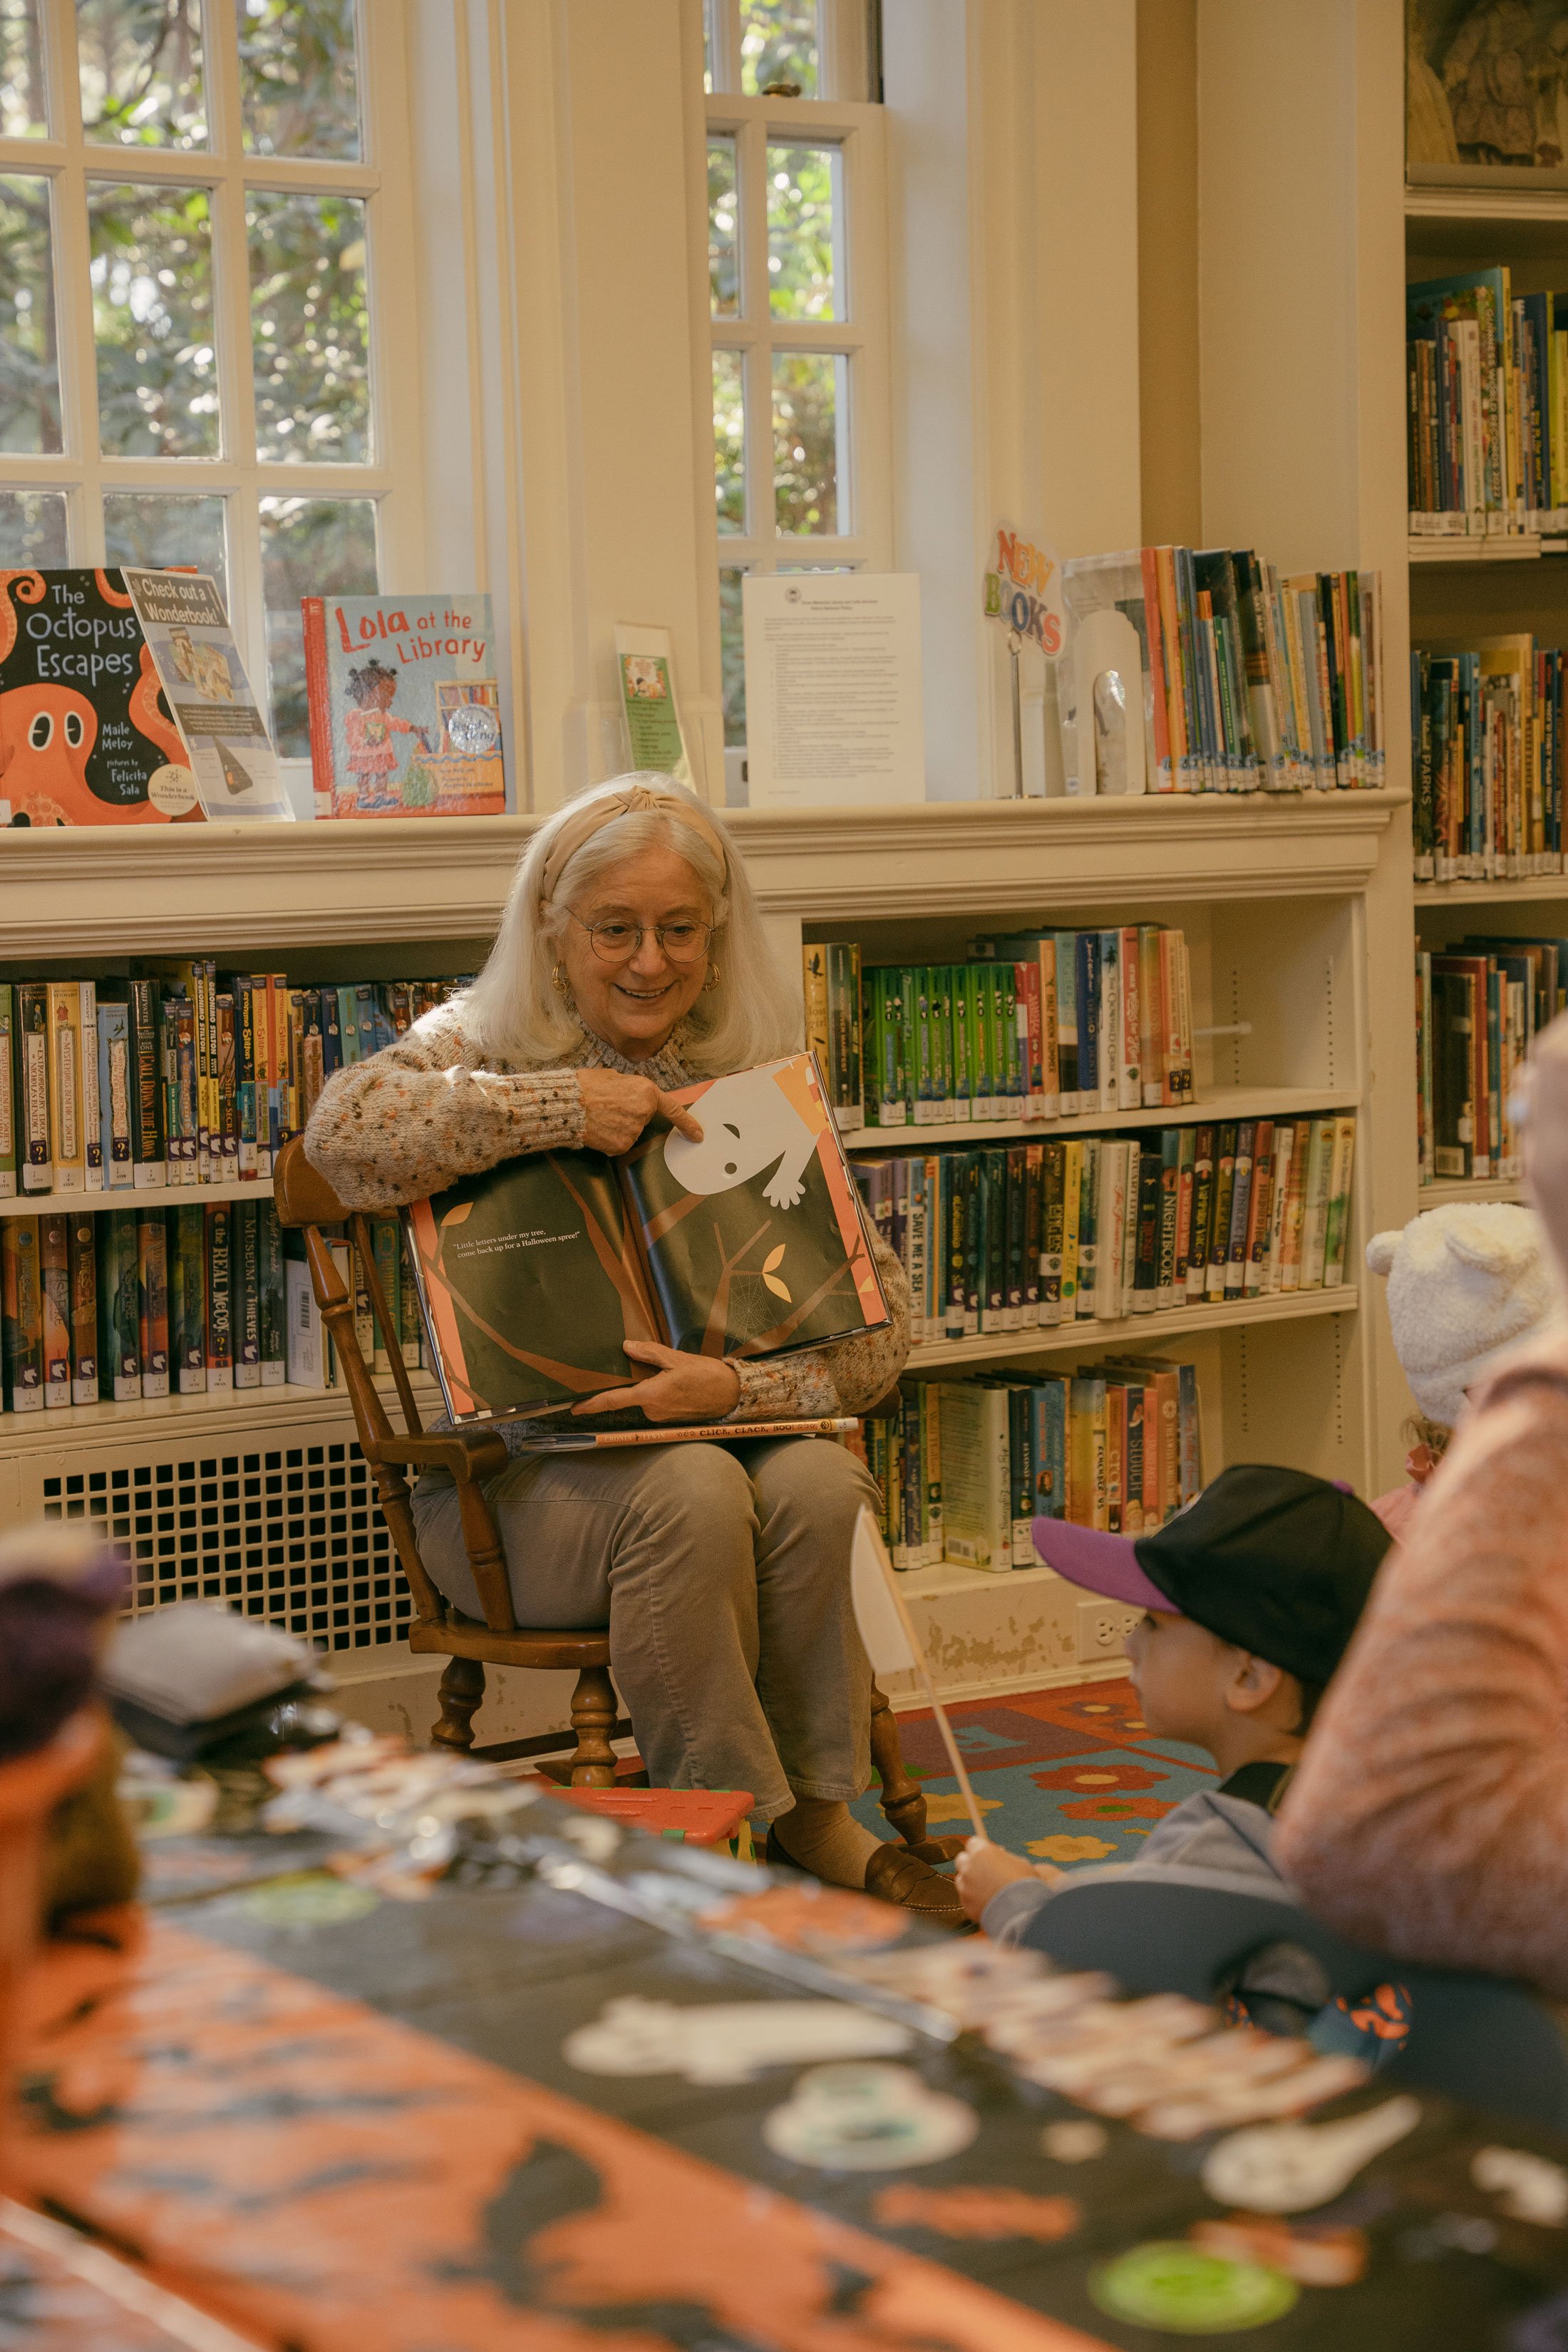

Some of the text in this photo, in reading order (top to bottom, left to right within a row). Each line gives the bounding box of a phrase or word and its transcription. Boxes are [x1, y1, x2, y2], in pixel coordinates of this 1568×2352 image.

[998, 530, 1056, 594] NEW
[52, 584, 85, 604] The
[142, 578, 206, 602] Check out a
[145, 602, 220, 626] Wonderbook!
[985, 572, 1061, 655] BOOKS
[26, 607, 136, 648] Octopus
[335, 607, 471, 653] Lola at the
[396, 638, 485, 664] Library
[37, 645, 133, 686] Escapes
[103, 721, 130, 736] Maile
[102, 738, 133, 751] Meloy
[107, 758, 138, 769] pictures by
[111, 768, 148, 783] Felicita
[120, 784, 140, 796] Sala
[1421, 755, 1431, 805] PARKS
[150, 792, 195, 800] Wonderbook
[242, 1028, 252, 1060] Stilton
[257, 1028, 265, 1059] Stilton
[1108, 1044, 1117, 1072] CURSE
[38, 1050, 46, 1109] EXTRAORDINARY
[64, 1090, 73, 1122] BENEDICT
[139, 1055, 158, 1159] CALL DOWN THE HAWK
[1130, 1151, 1140, 1195] STUART
[215, 1228, 226, 1244] the
[912, 1213, 924, 1240] SAVE
[1160, 1192, 1177, 1288] NIGHTBOOKS
[244, 1219, 256, 1280] MUSEUM
[264, 1212, 279, 1273] Night Parade
[477, 1246, 493, 1254] back
[522, 1236, 557, 1247] Halloween
[912, 1243, 924, 1259] ME
[1048, 1234, 1064, 1254] LOS
[213, 1247, 229, 1288] REAL
[912, 1273, 924, 1293] SEA
[246, 1295, 258, 1340] THIEVES
[604, 1423, 795, 1443] CRONIN LEWIN CLICK, CLACK, BOO!
[1097, 1497, 1105, 1510] US
